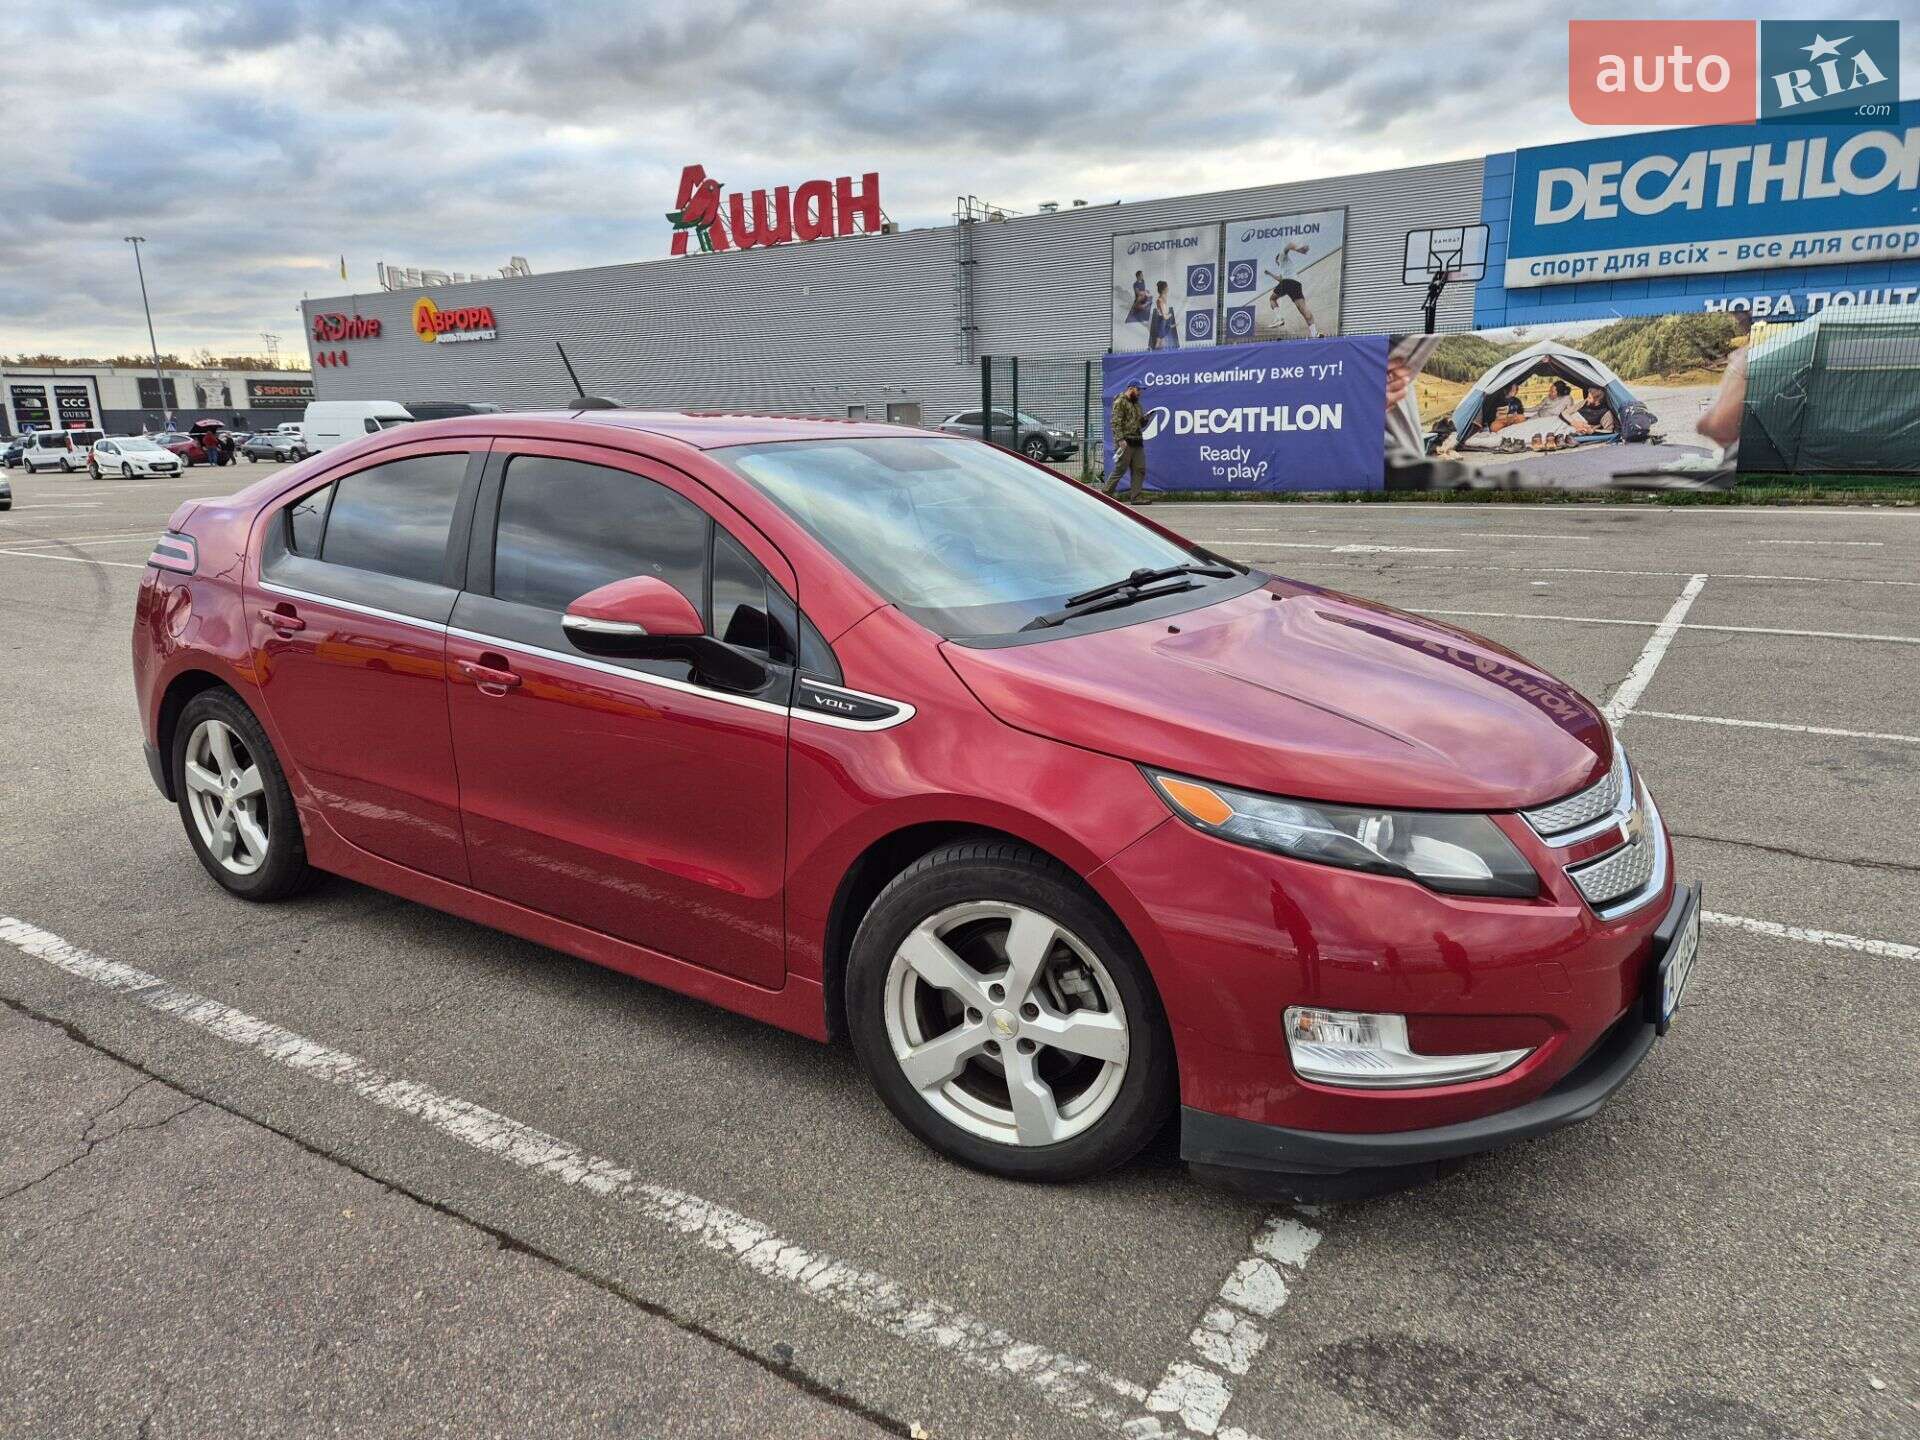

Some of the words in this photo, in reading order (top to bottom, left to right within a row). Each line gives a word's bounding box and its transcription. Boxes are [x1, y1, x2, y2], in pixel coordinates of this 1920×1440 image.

[1257, 223, 1320, 240] DECATHLON
[1141, 236, 1199, 252] DECATHLON
[1530, 257, 1599, 278] спорт
[1603, 252, 1650, 273] для
[1658, 244, 1710, 266] всіх
[1737, 242, 1783, 260] все
[1790, 237, 1842, 259] для
[1198, 273, 1205, 284] 2
[1703, 294, 1796, 317] НОВА
[1807, 287, 1920, 314] ПОШТ
[416, 305, 494, 333] АВРОРА
[1144, 371, 1190, 387] Сезон
[1194, 366, 1267, 384] кемпінгу
[1271, 365, 1305, 379] вже
[1309, 360, 1344, 381] тут!
[61, 398, 87, 407] CCC
[1174, 403, 1343, 435] DECATHLON
[1200, 445, 1251, 464] Ready
[1212, 466, 1225, 476] to
[1227, 461, 1268, 482] play?
[814, 693, 857, 711] VOLT
